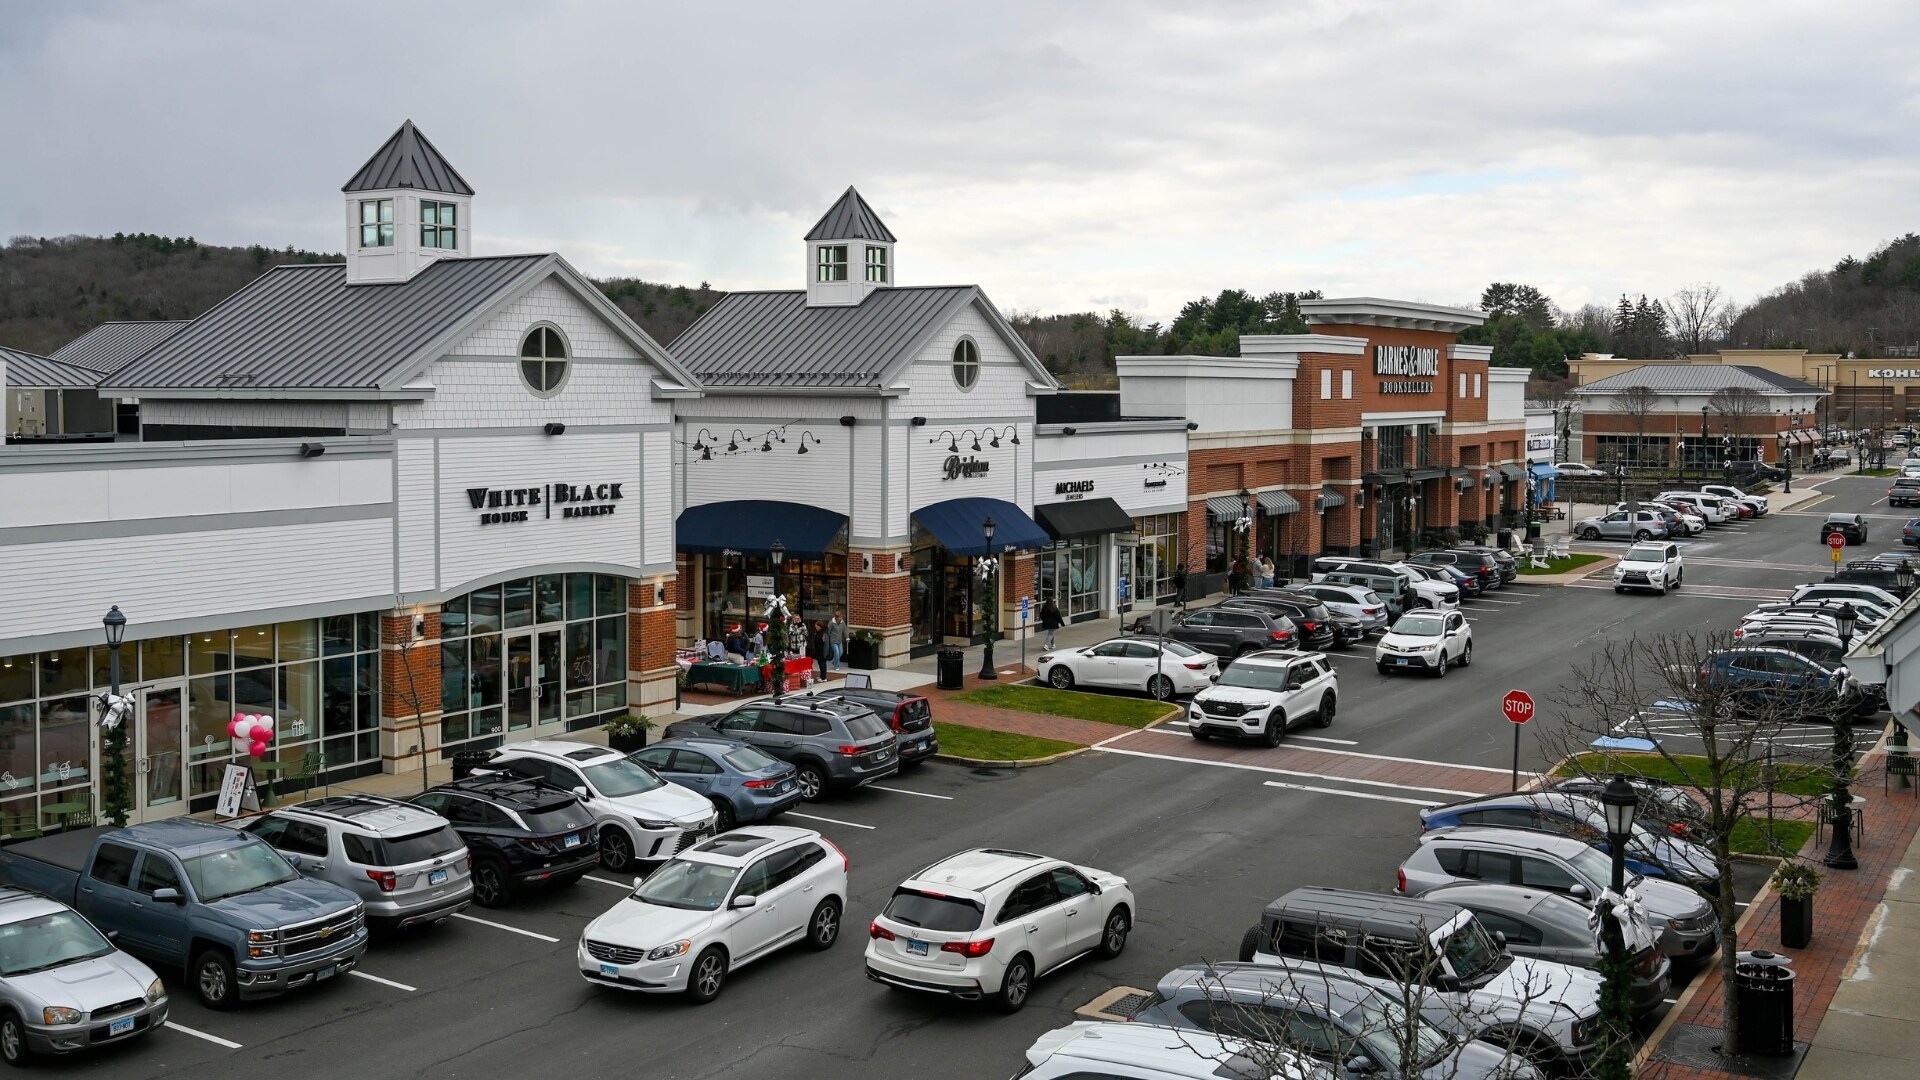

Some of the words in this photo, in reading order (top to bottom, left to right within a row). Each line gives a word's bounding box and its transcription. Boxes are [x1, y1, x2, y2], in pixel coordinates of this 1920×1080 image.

[1382, 381, 1434, 394] BOOKSELLERS
[942, 454, 990, 480] Brighton
[1055, 480, 1095, 495] MICHAELS
[467, 487, 542, 509] WHITE
[554, 483, 624, 503] BLACK
[1065, 493, 1084, 501] JEWELERS
[481, 510, 529, 525] HOUSE
[563, 504, 616, 518] MARKET
[1828, 537, 1844, 545] STOP
[1505, 699, 1532, 715] STOP
[490, 725, 501, 733] 900
